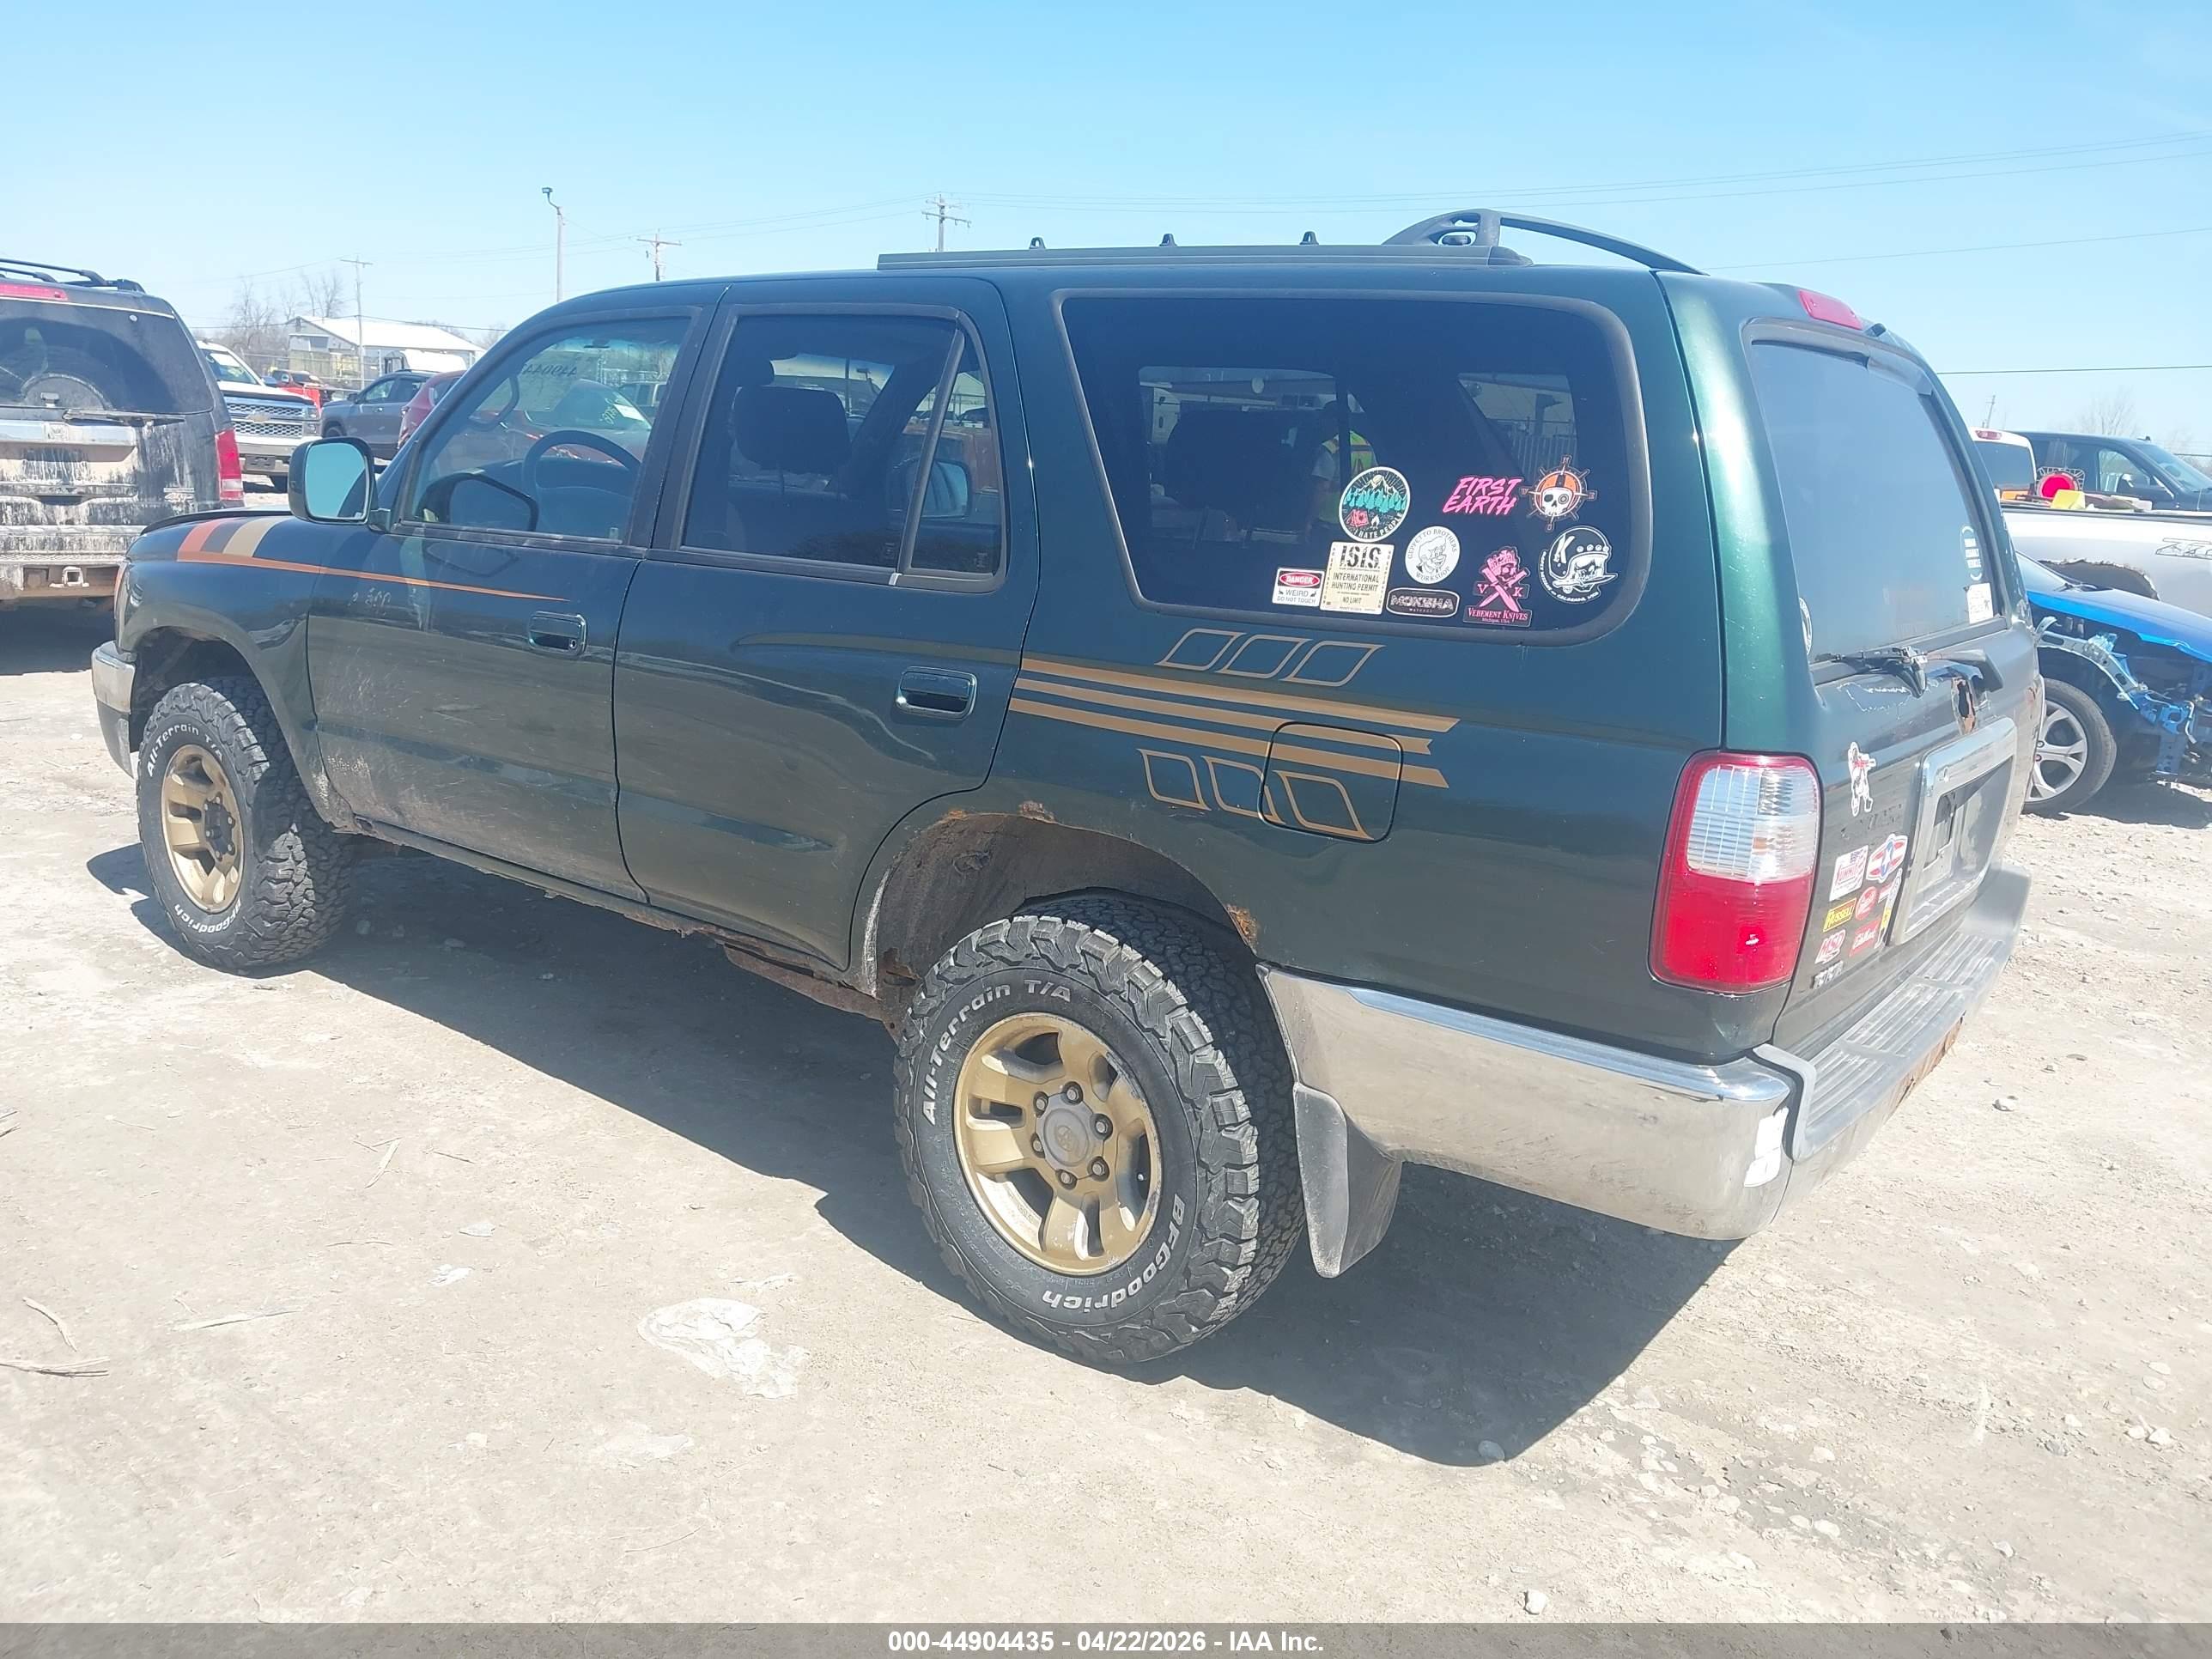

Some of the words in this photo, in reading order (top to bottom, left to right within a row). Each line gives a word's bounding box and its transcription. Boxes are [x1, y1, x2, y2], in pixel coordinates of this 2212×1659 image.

[1453, 477, 1522, 496] FIRST
[1442, 495, 1517, 515] EARTH
[1358, 531, 1378, 539] HATE
[1379, 512, 1403, 537] PEOPLE
[1433, 528, 1458, 552] BROTHERS
[1553, 532, 1575, 564] K
[1285, 574, 1313, 585] DANGER
[1333, 572, 1379, 584] INTERNATIONAL
[1416, 566, 1450, 581] WORKSHOP
[1331, 581, 1357, 591] HUNTING
[1468, 607, 1502, 619] VEHEMENT
[1503, 610, 1528, 623] KNIVES
[147, 724, 200, 777] All-Terrain
[204, 734, 224, 763] T/A
[174, 896, 242, 935] BFGoodrich
[923, 981, 1011, 1127] All-Terrain
[1024, 979, 1073, 1003] T/A
[1041, 1192, 1186, 1314] BFGoodrich
